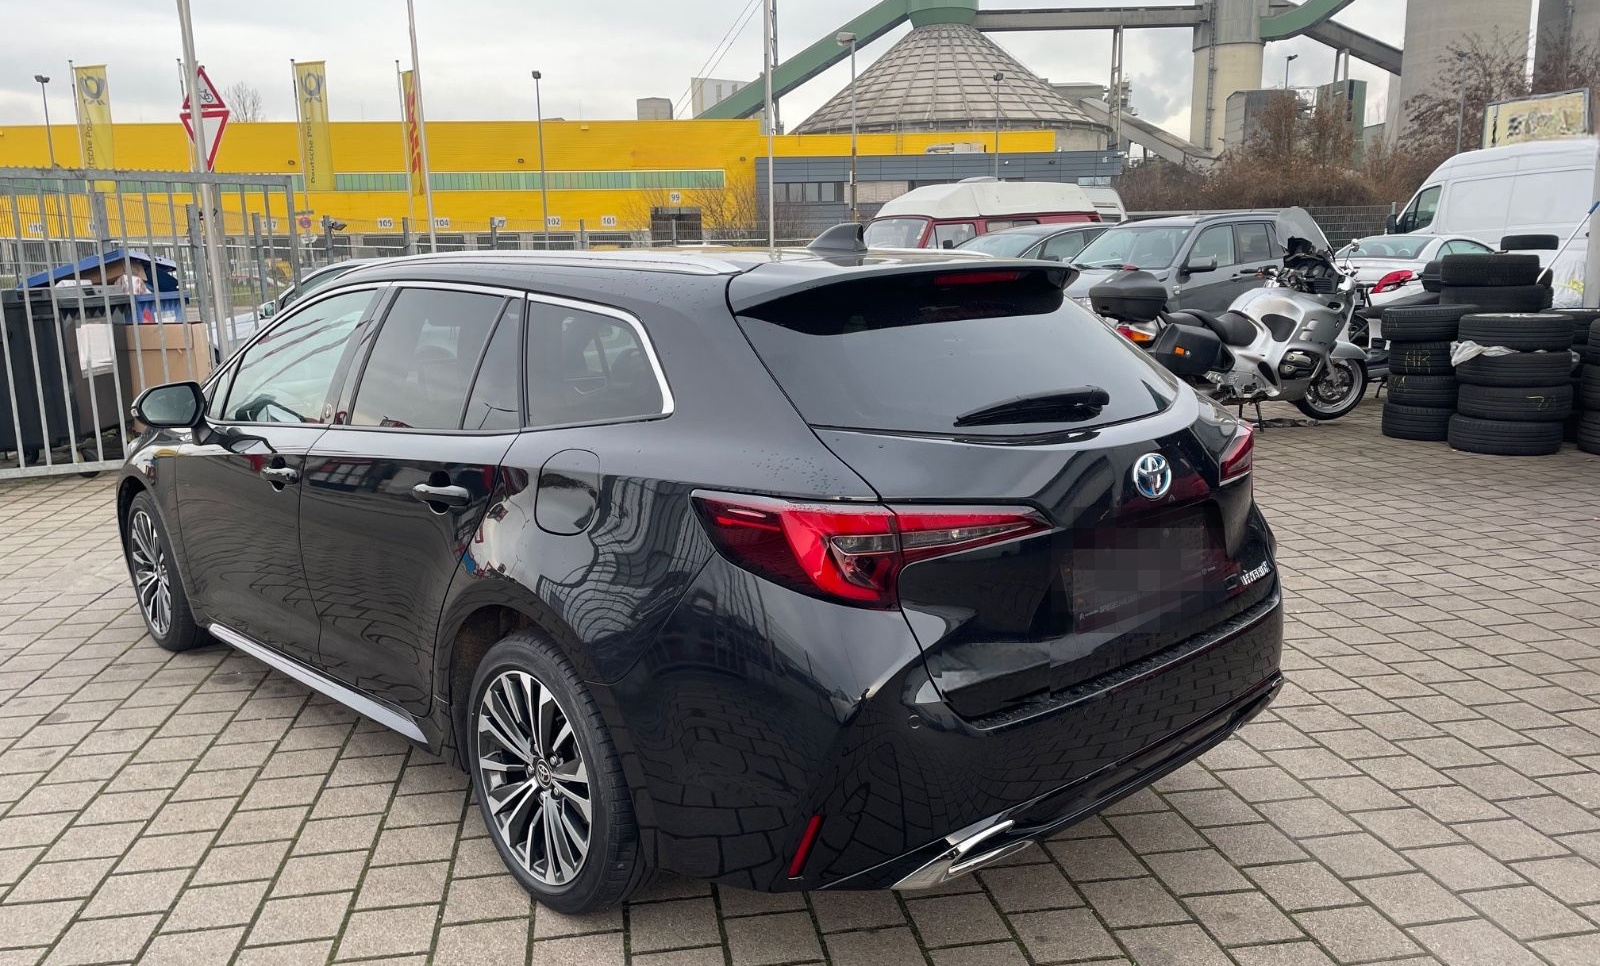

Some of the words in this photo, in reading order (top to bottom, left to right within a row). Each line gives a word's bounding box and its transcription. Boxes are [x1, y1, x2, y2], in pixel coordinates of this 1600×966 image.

[305, 116, 313, 138] Post
[308, 139, 316, 184] Deutsche
[671, 193, 680, 202] 99
[379, 219, 393, 228] 105
[435, 219, 449, 227] 104
[547, 217, 561, 226] 102
[602, 217, 616, 225] 101
